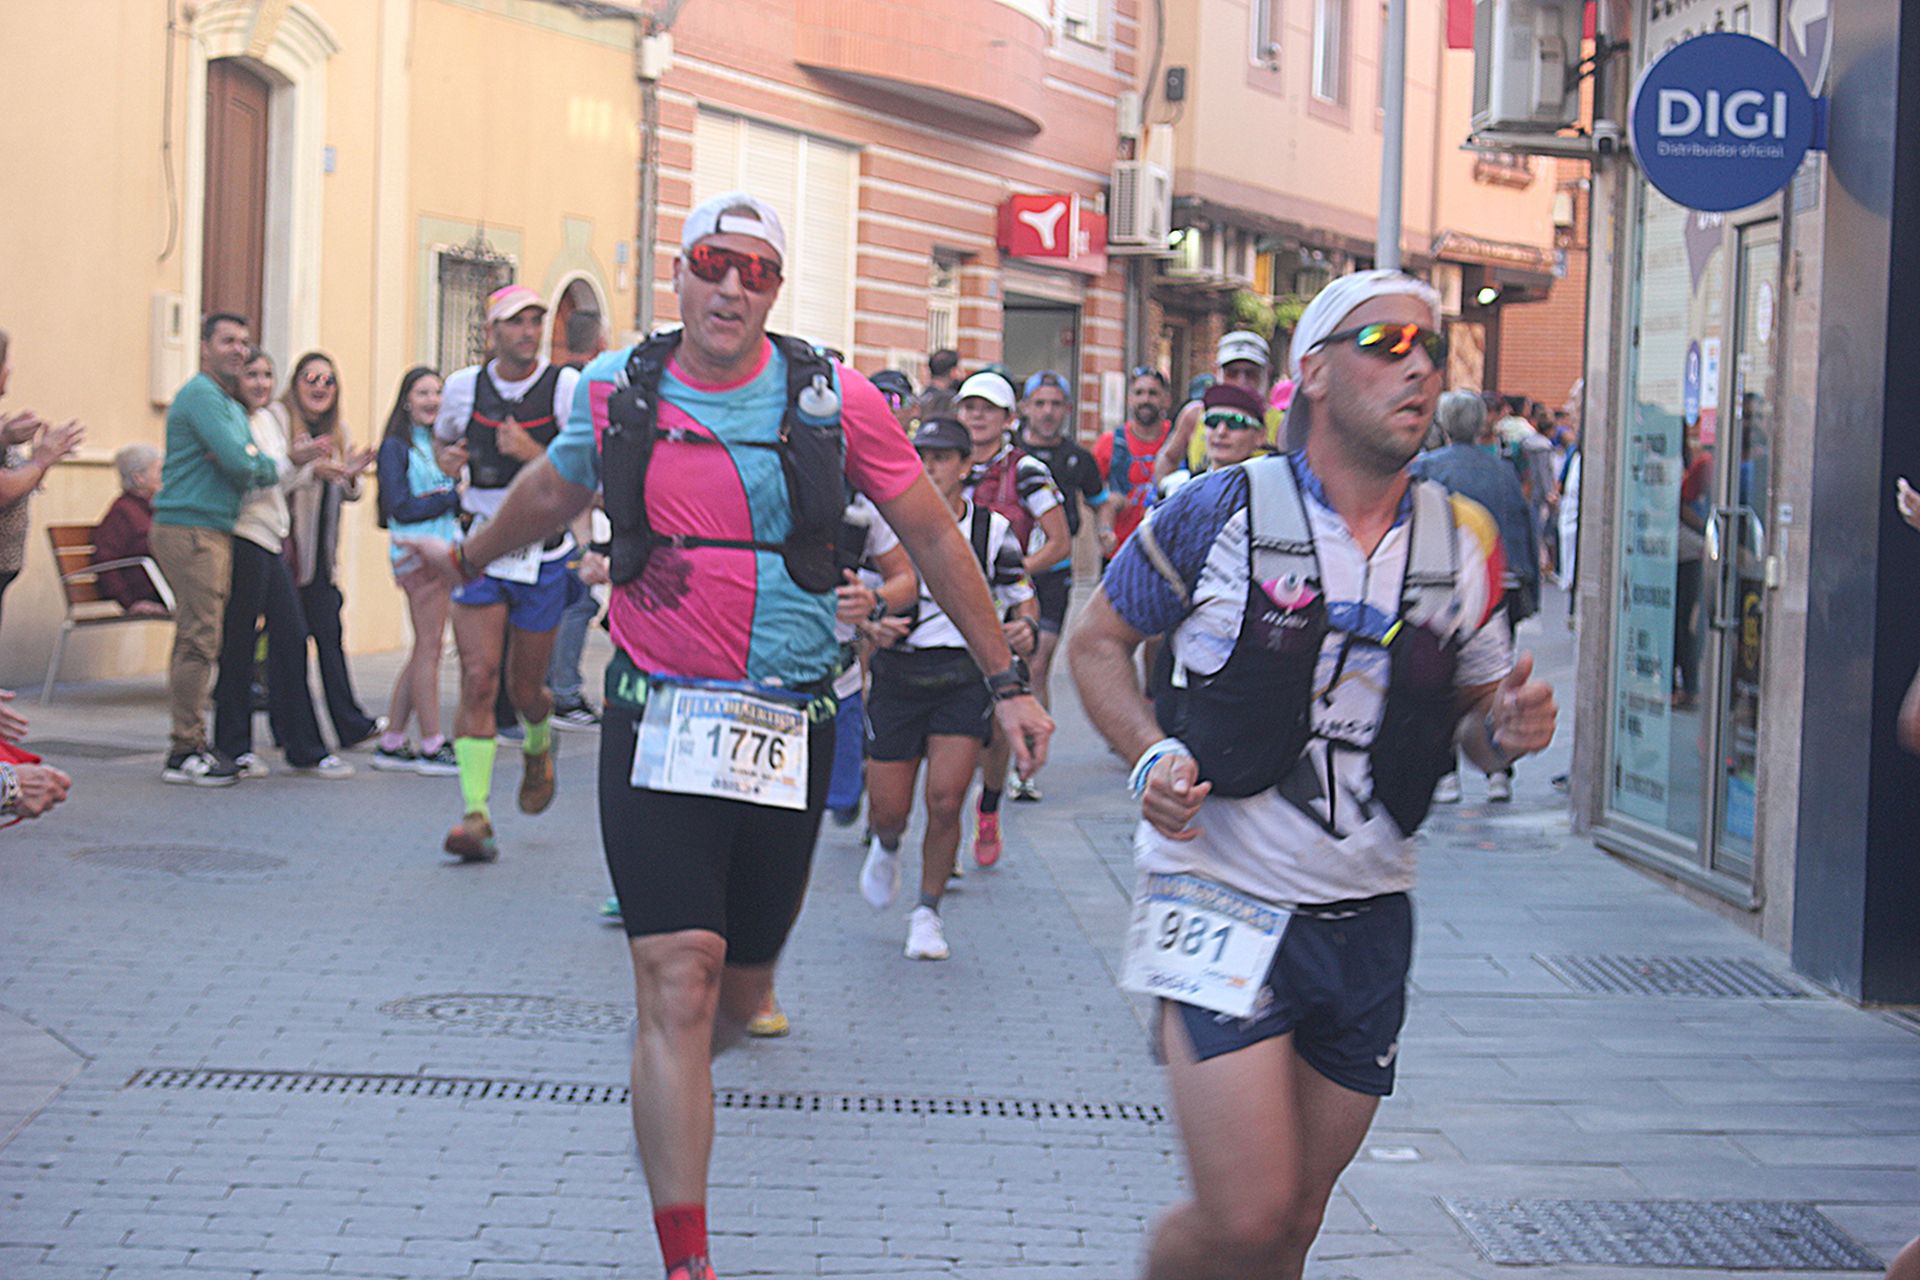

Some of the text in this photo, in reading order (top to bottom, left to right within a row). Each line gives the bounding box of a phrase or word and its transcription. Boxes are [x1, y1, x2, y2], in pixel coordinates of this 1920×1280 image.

[1658, 89, 1786, 138] DIGI
[1657, 141, 1784, 158] Distribuidor oficial
[706, 723, 786, 770] 1776
[1157, 909, 1234, 964] 981
